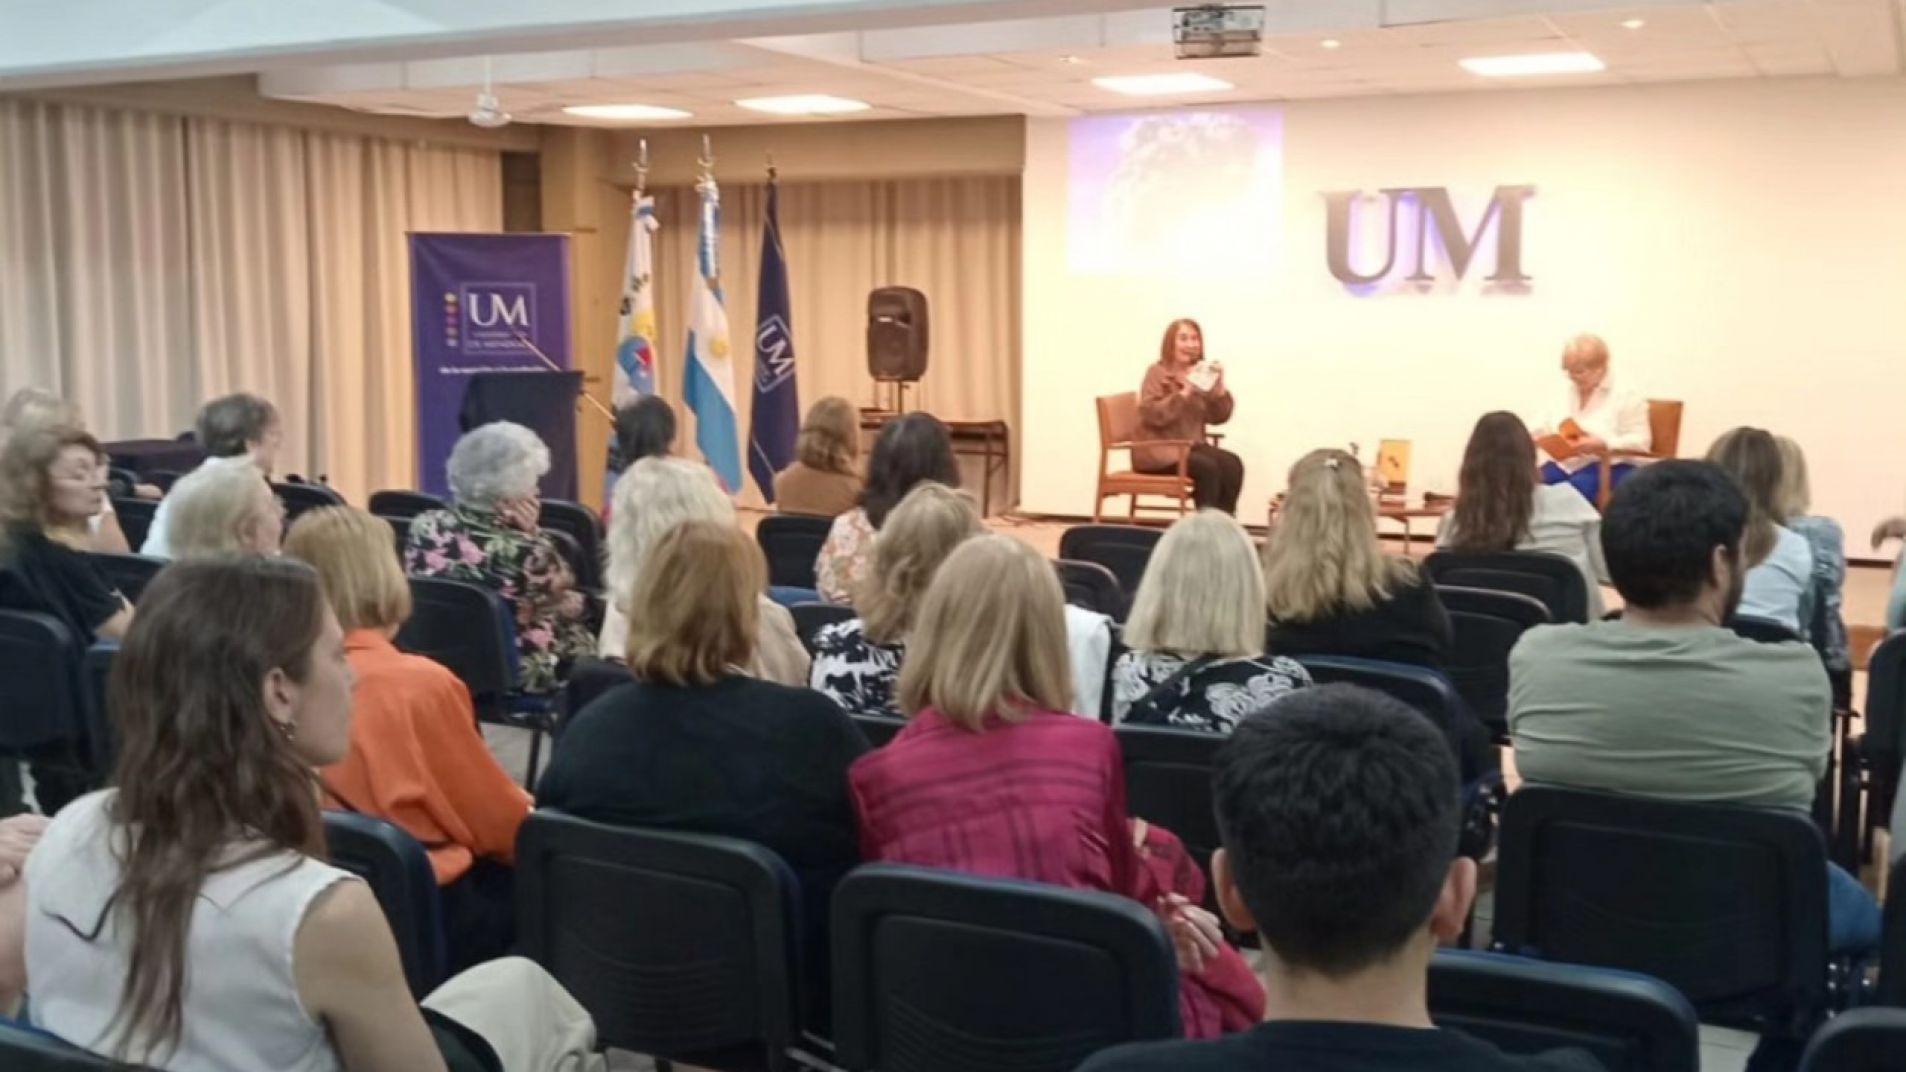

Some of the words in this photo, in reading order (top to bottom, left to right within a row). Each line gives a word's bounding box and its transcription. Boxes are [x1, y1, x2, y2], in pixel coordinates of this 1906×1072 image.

[1318, 184, 1537, 283] UM
[467, 292, 530, 327] UM
[758, 324, 795, 376] UM
